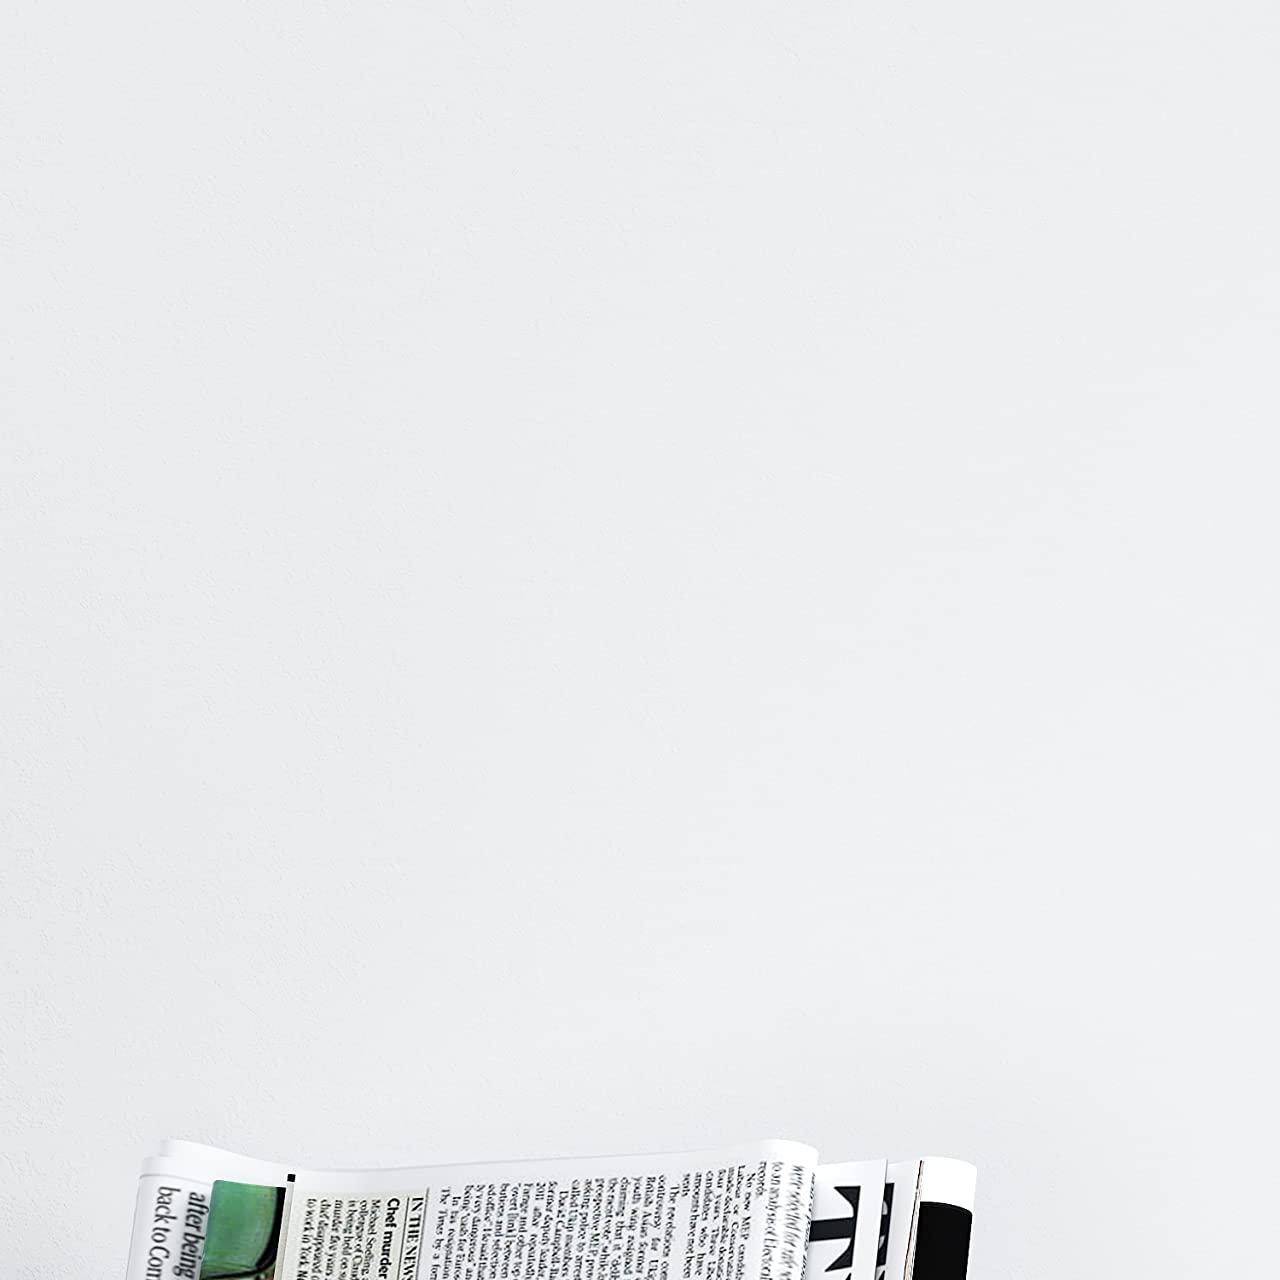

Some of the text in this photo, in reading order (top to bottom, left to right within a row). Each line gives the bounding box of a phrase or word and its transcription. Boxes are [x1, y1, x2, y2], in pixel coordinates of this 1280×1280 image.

[154, 1186, 179, 1223] back
[185, 1192, 209, 1231] after
[385, 1198, 400, 1227] Chef
[411, 1197, 424, 1211] IN
[151, 1227, 171, 1243] to
[407, 1214, 421, 1242] THE
[174, 1232, 205, 1279] being
[378, 1231, 393, 1279] murder
